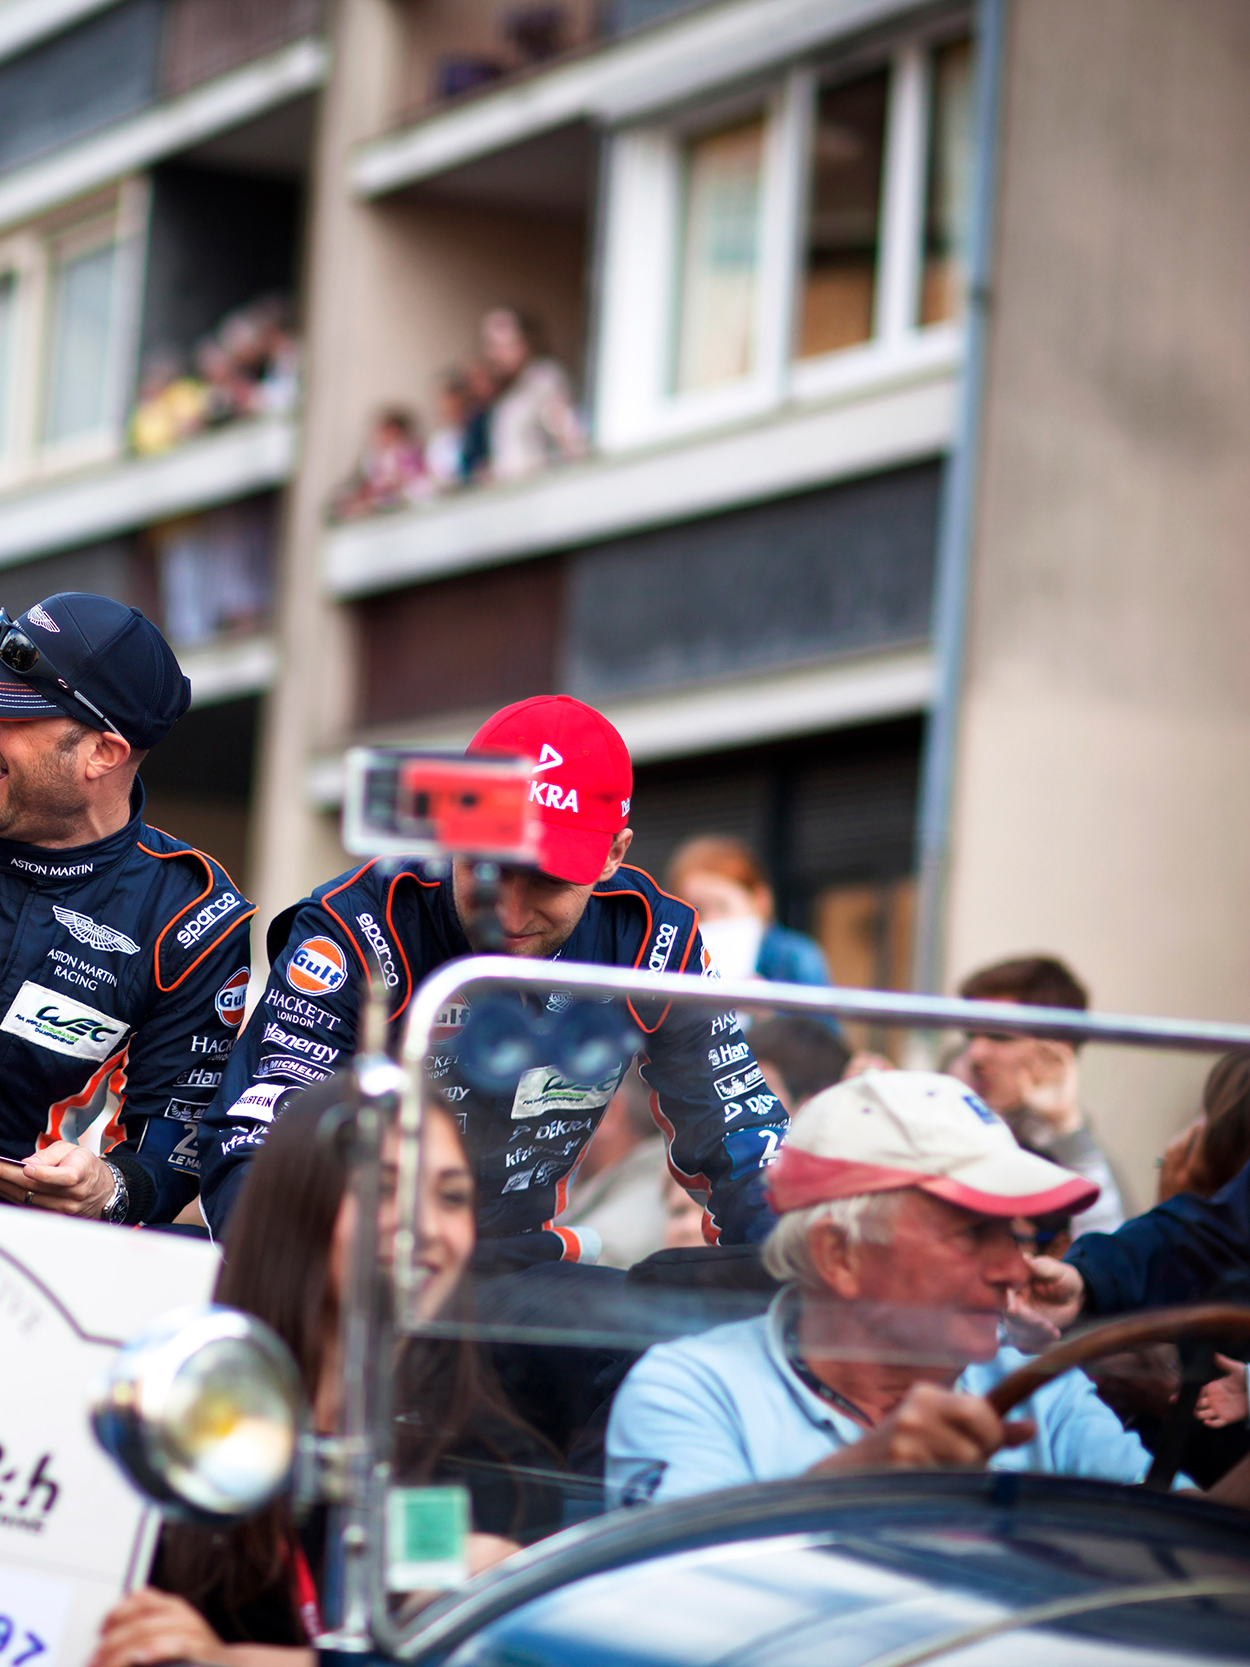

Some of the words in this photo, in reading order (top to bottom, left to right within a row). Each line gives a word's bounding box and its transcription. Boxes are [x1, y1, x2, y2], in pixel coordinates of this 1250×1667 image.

[10, 858, 47, 875] ASTON
[49, 862, 94, 877] MARTIN
[177, 892, 241, 949] sparco
[46, 948, 78, 968] ASTON
[80, 960, 118, 988] MARTIN
[293, 950, 343, 987] Gulf
[356, 912, 400, 990] sparco
[54, 965, 99, 991] RACING
[35, 1005, 119, 1043] WEC
[264, 989, 341, 1031] HACKETT
[277, 1010, 315, 1029] LONDON
[263, 1022, 339, 1064] Hanergy
[269, 1060, 328, 1082] MICHELIN
[167, 1153, 186, 1165] LE
